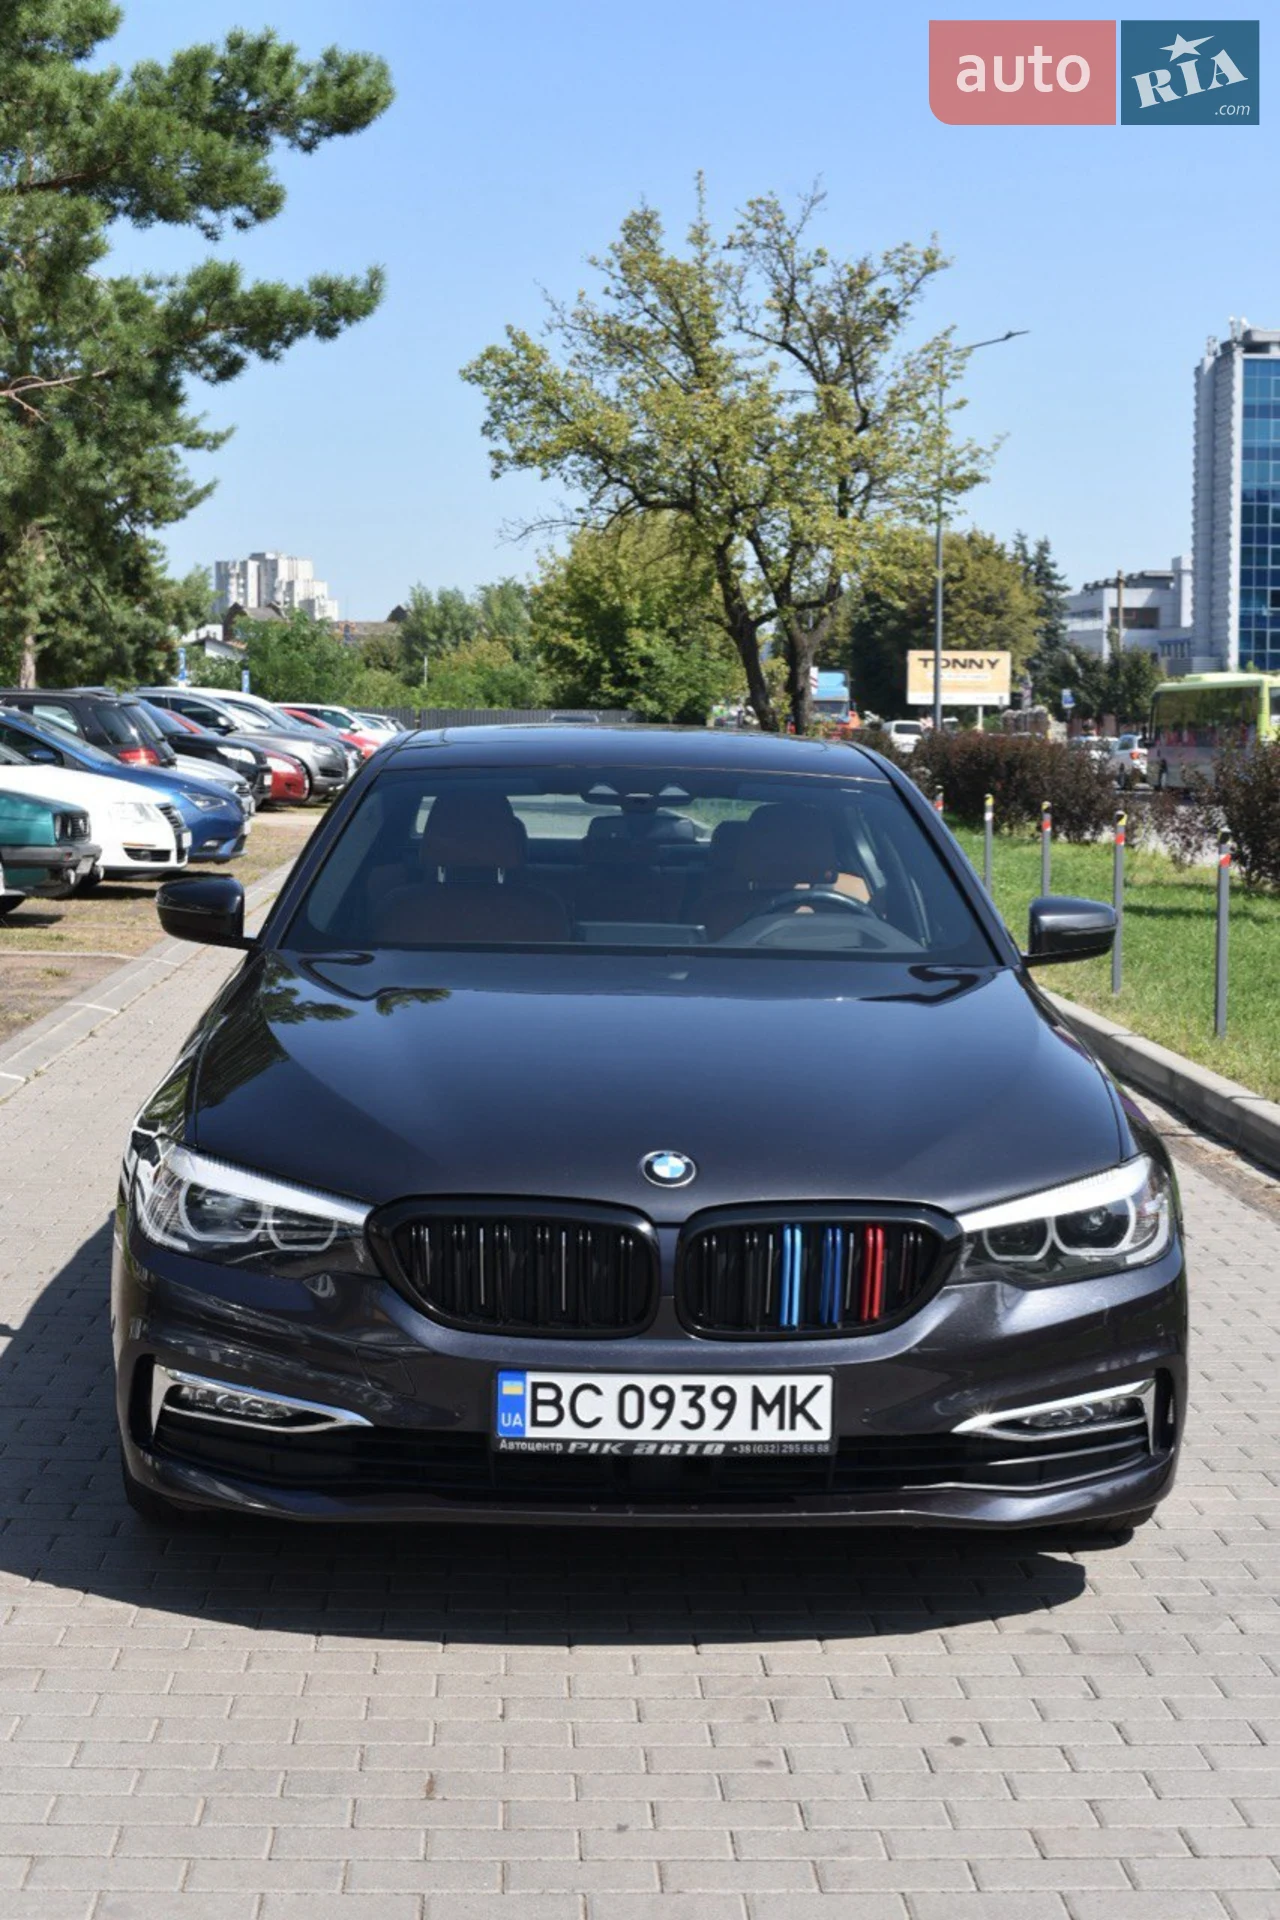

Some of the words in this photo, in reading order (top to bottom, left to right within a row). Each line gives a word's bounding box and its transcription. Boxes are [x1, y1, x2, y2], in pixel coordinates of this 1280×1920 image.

[530, 1381, 604, 1430] BC
[617, 1384, 737, 1431] 0939
[750, 1385, 823, 1431] MK
[501, 1413, 523, 1428] UA
[499, 1439, 564, 1454] Автоцентр
